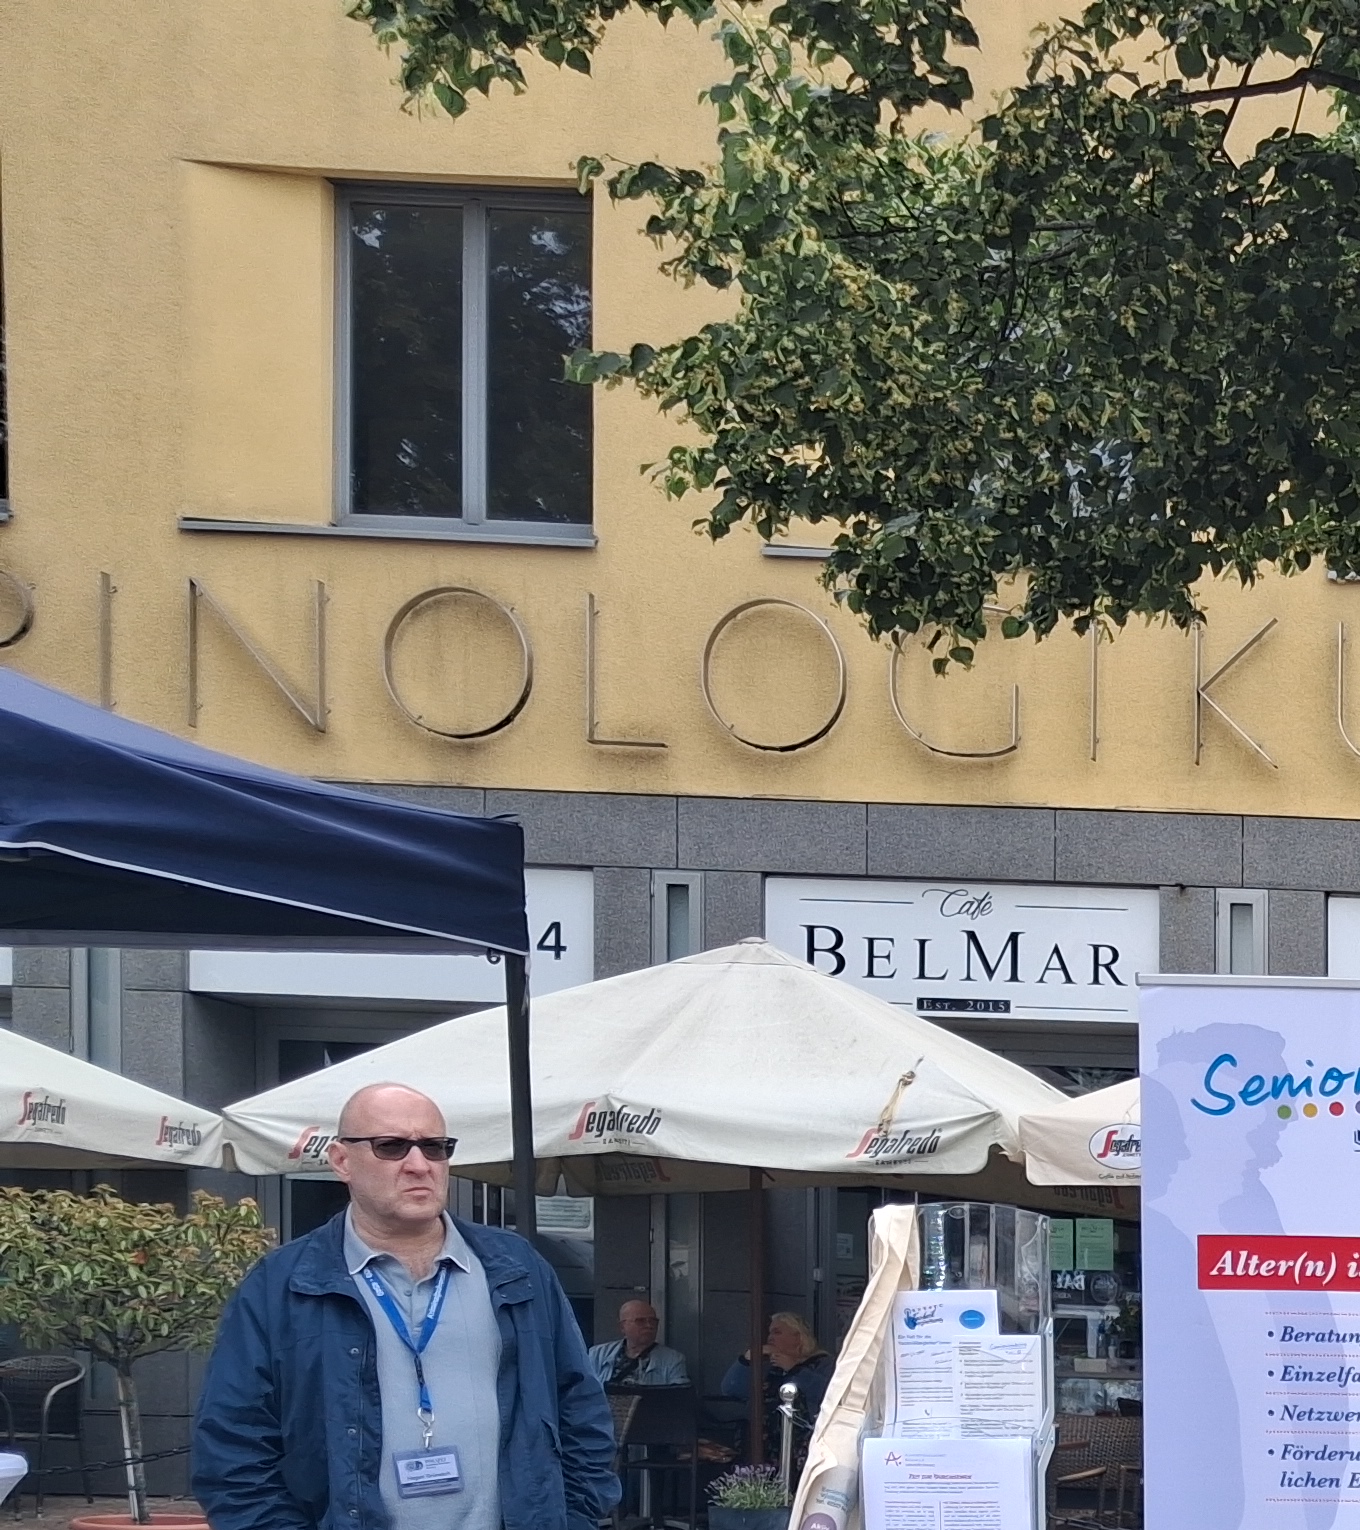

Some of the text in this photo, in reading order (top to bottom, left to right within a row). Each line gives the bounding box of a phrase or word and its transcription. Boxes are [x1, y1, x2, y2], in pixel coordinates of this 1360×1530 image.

[922, 889, 993, 920] Café
[966, 1000, 1006, 1012] 2015
[18, 1091, 66, 1126] Segafredo
[568, 1101, 662, 1141] Segafredo
[845, 1127, 942, 1159] Segafredo
[1208, 1247, 1340, 1287] Alter(n)
[1280, 1472, 1341, 1490] lichen
